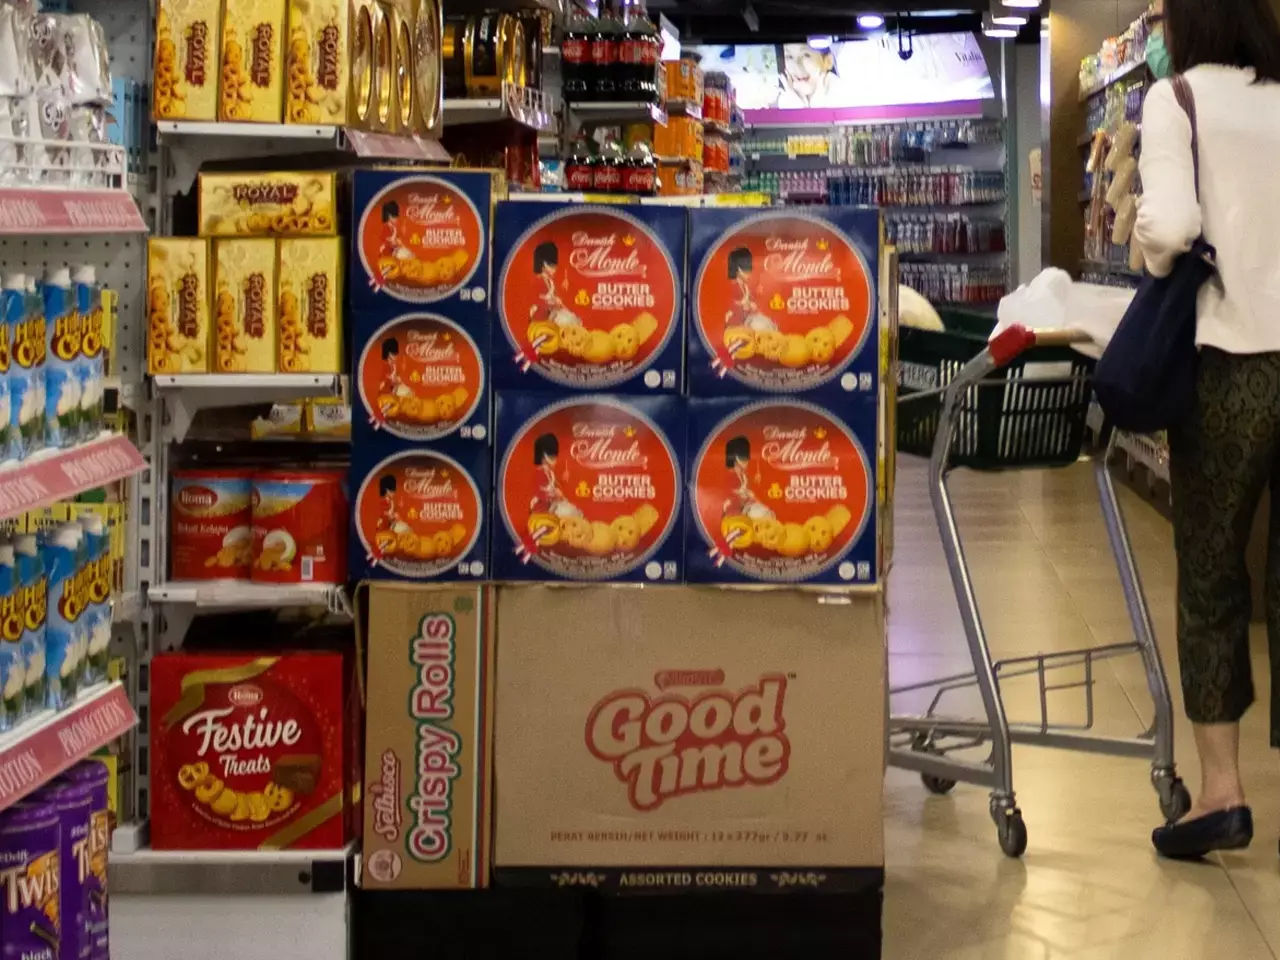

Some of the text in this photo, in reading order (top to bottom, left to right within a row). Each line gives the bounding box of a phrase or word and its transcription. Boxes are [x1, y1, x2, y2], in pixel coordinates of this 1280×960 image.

[192, 22, 206, 87] ROYAL
[256, 24, 272, 87] ROYAL
[323, 25, 338, 90] ROYAL
[235, 185, 295, 201] ROYAL
[569, 245, 640, 272] Monde
[764, 249, 833, 277] Monde
[591, 293, 655, 308] COOKIES
[597, 282, 650, 294] BUTTER
[792, 287, 845, 298] BUTTER
[184, 273, 199, 338] ROYAL
[250, 273, 265, 339] ROYAL
[312, 273, 328, 339] ROYAL
[787, 297, 850, 312] COOKIES
[570, 437, 640, 463] Monde
[761, 439, 831, 464] Monde
[592, 486, 656, 500] COOKIES
[598, 475, 651, 487] BUTTER
[784, 486, 848, 500] COOKIES
[790, 474, 843, 487] BUTTER
[58, 697, 127, 757] PROMOTION
[589, 673, 787, 754] Good
[182, 705, 302, 757] Festive
[406, 614, 460, 859] Crispy Rolls
[218, 753, 271, 779] Treats
[617, 735, 788, 809] Time
[0, 855, 59, 915] Twis
[619, 872, 758, 886] ASSORTED COOKIES
